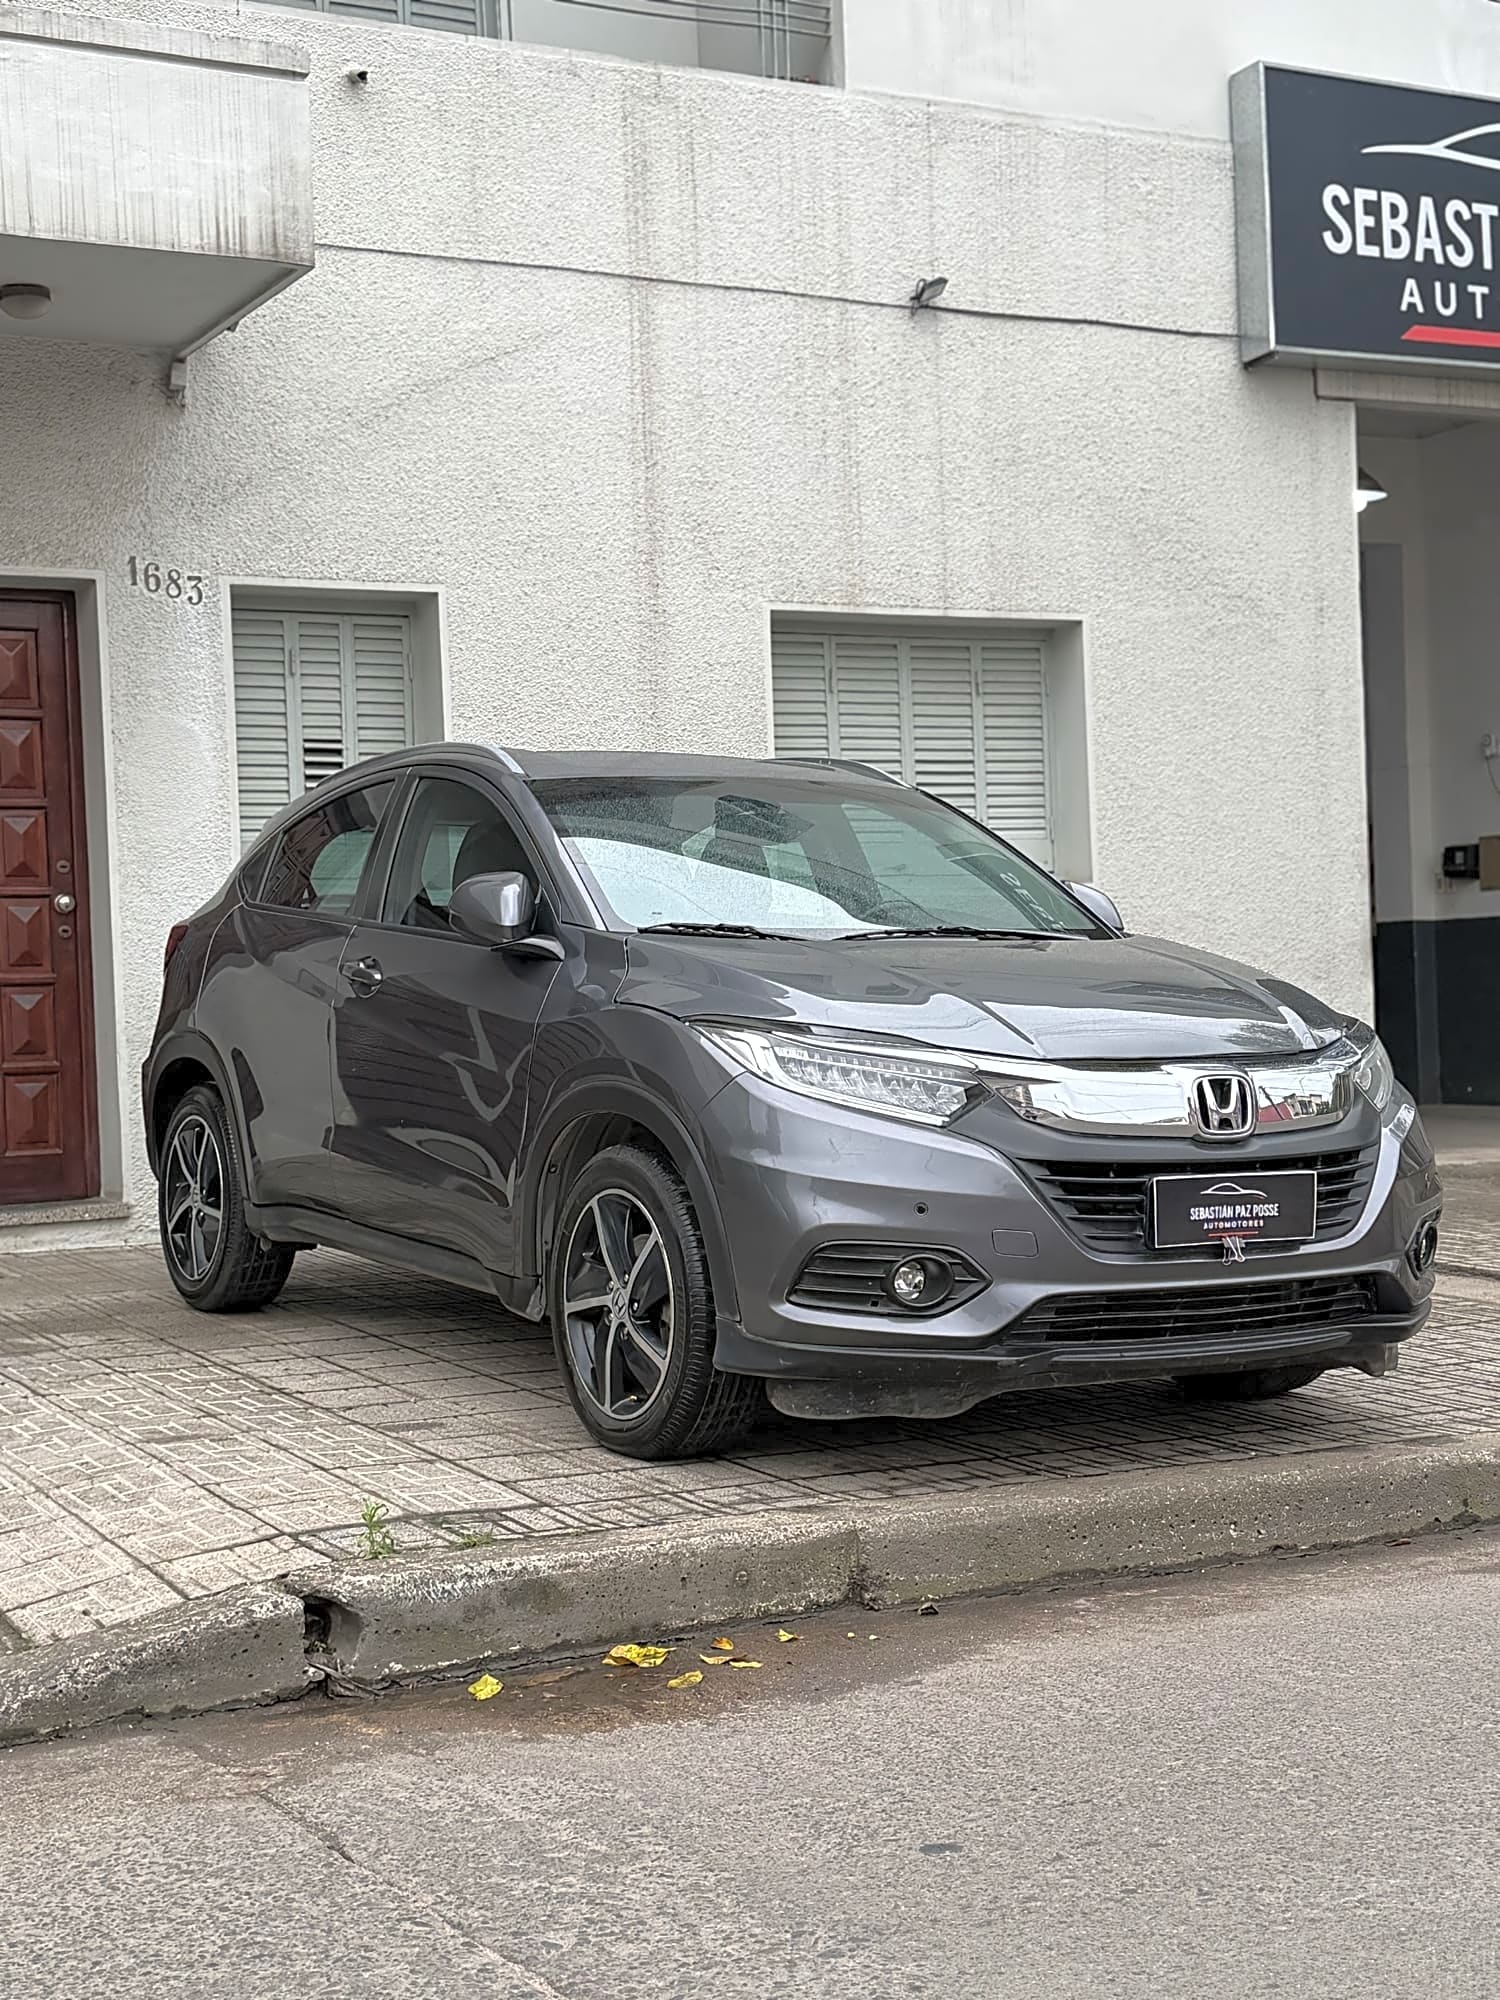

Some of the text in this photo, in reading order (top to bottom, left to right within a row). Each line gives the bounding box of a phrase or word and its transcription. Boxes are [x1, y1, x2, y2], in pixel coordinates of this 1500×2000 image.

[1321, 183, 1499, 271] SEBAST
[1400, 278, 1490, 320] AUT
[127, 555, 203, 606] 1683
[1203, 1219, 1264, 1230] AUTOMOTORES
[1235, 1204, 1252, 1218] PAZ
[1253, 1203, 1280, 1217] POSSE
